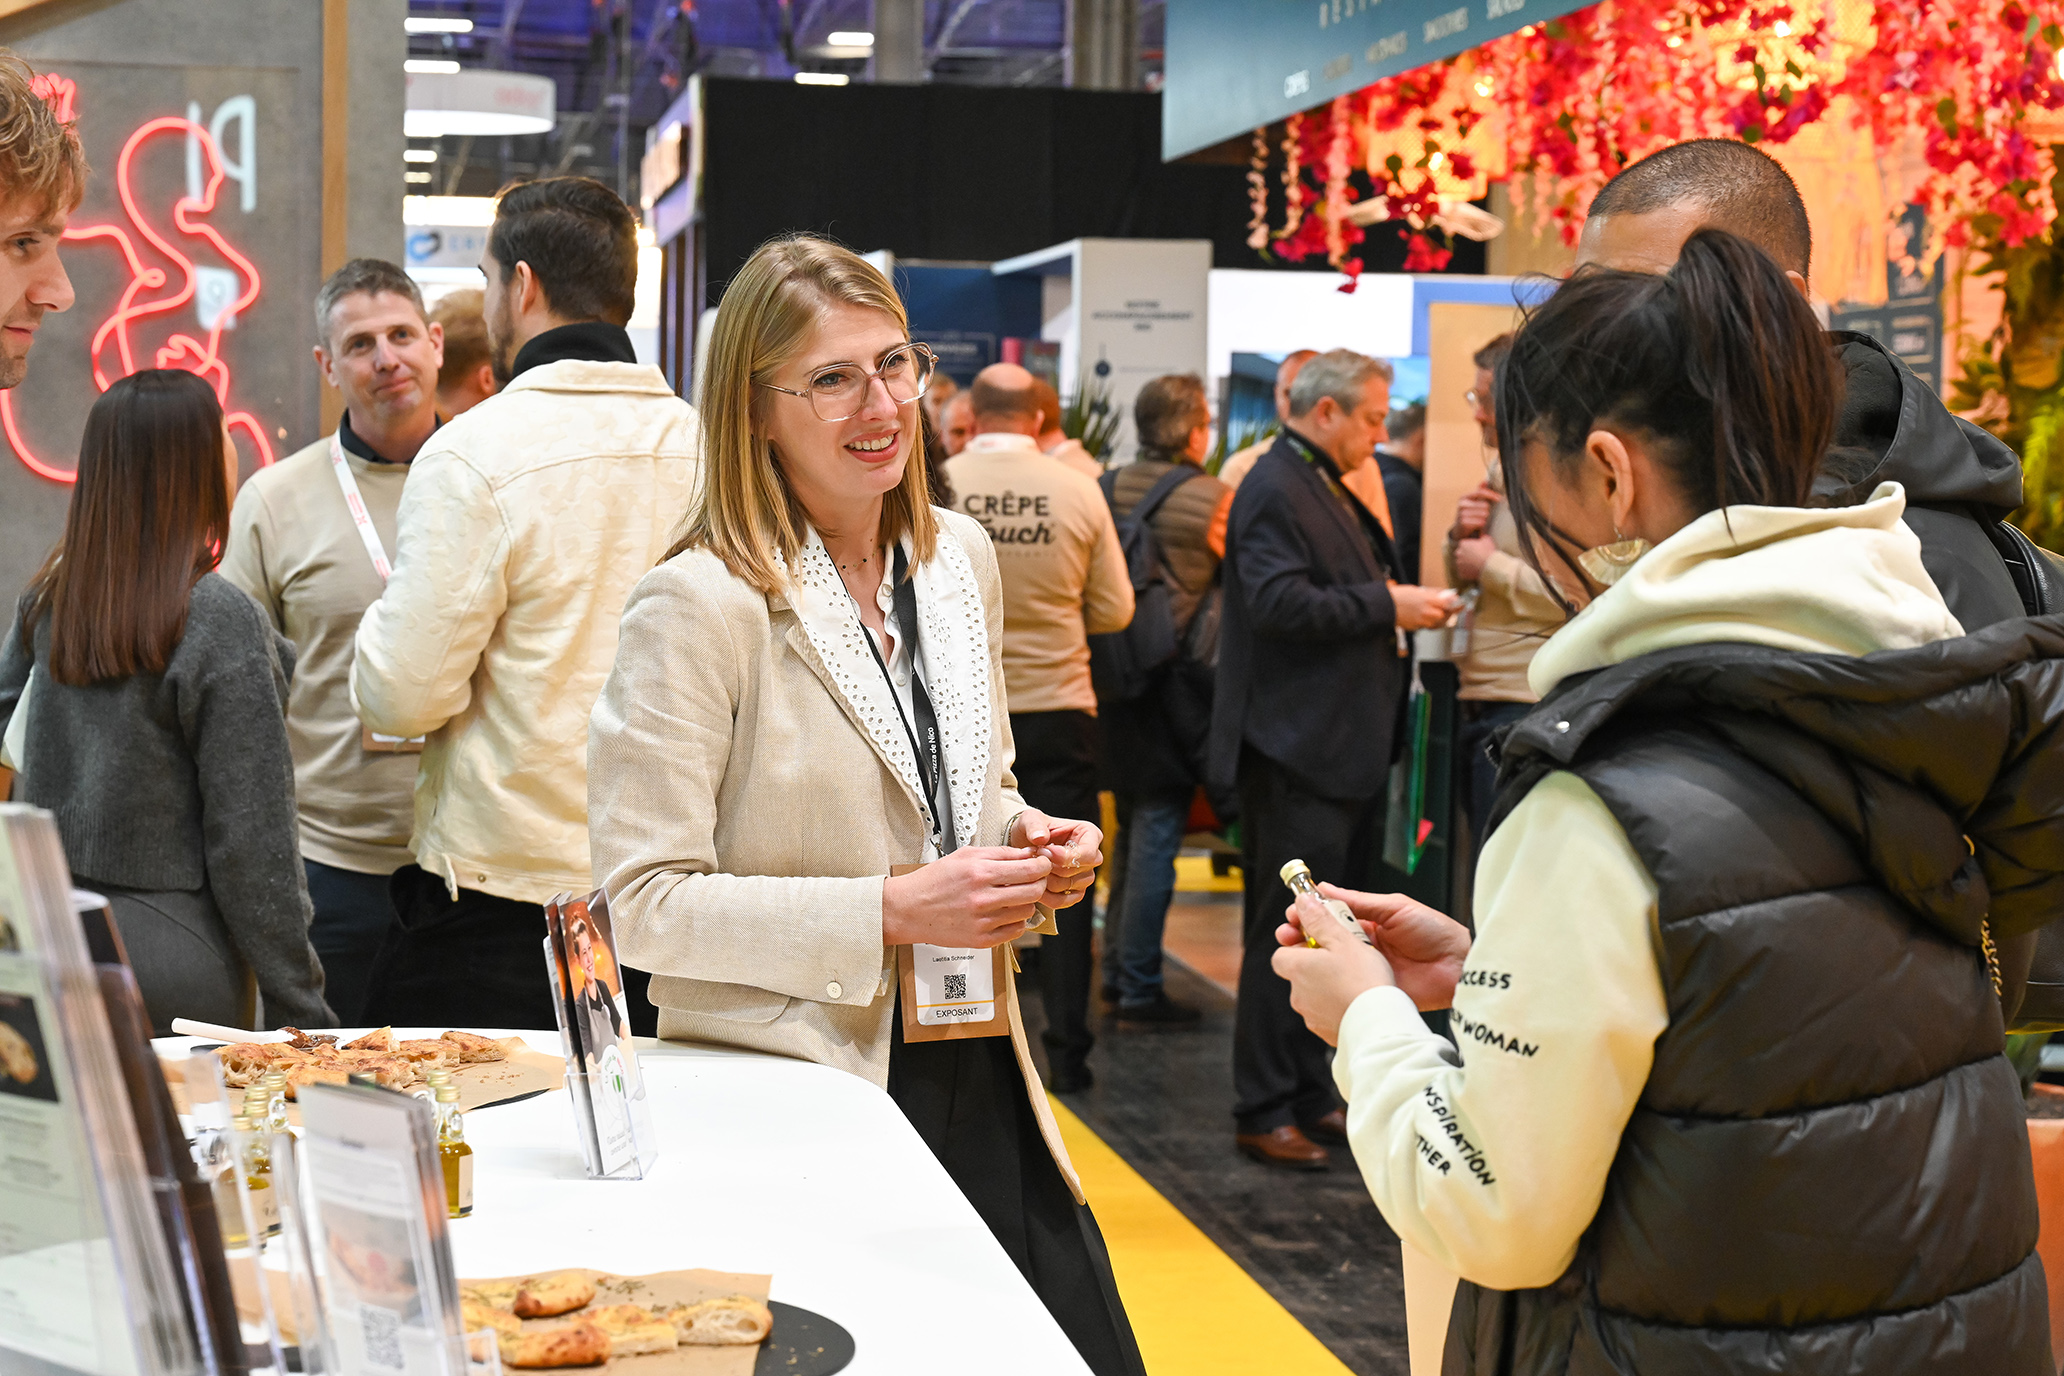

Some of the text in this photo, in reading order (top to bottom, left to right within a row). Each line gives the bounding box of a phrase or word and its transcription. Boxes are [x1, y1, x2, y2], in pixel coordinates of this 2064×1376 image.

[964, 489, 1049, 516] CRÊPE
[980, 517, 1055, 545] ouch
[927, 727, 936, 744] Nico
[930, 744, 937, 754] de
[1459, 970, 1512, 989] CCESS
[936, 1007, 978, 1018] EXPOSANT
[1463, 1020, 1539, 1057] WOMAN
[1423, 1086, 1497, 1186] NSPIRATION
[1415, 1133, 1451, 1176] THER
